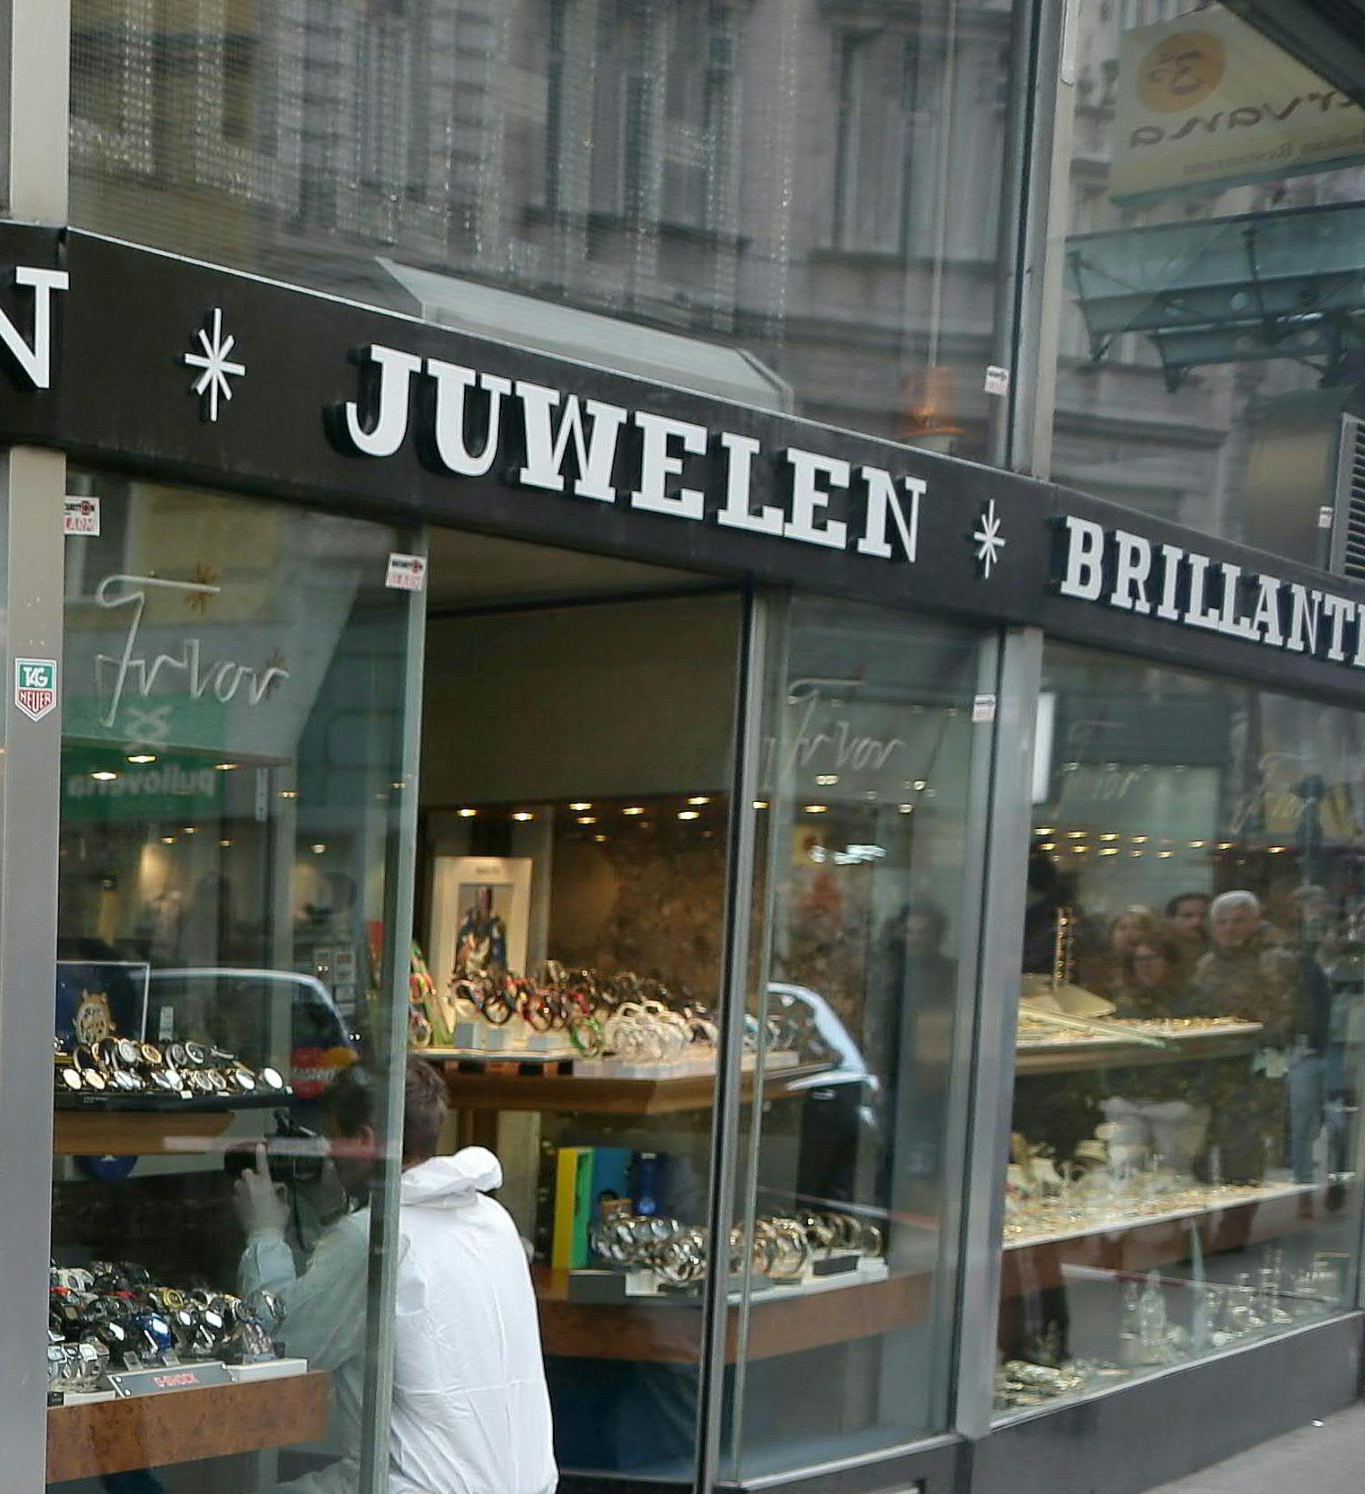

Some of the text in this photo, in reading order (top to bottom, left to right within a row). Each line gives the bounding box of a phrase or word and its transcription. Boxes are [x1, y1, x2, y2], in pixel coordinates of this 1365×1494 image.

[345, 343, 927, 563] JUWELEN
[23, 666, 48, 688] TAG
[19, 690, 53, 713] HEUER
